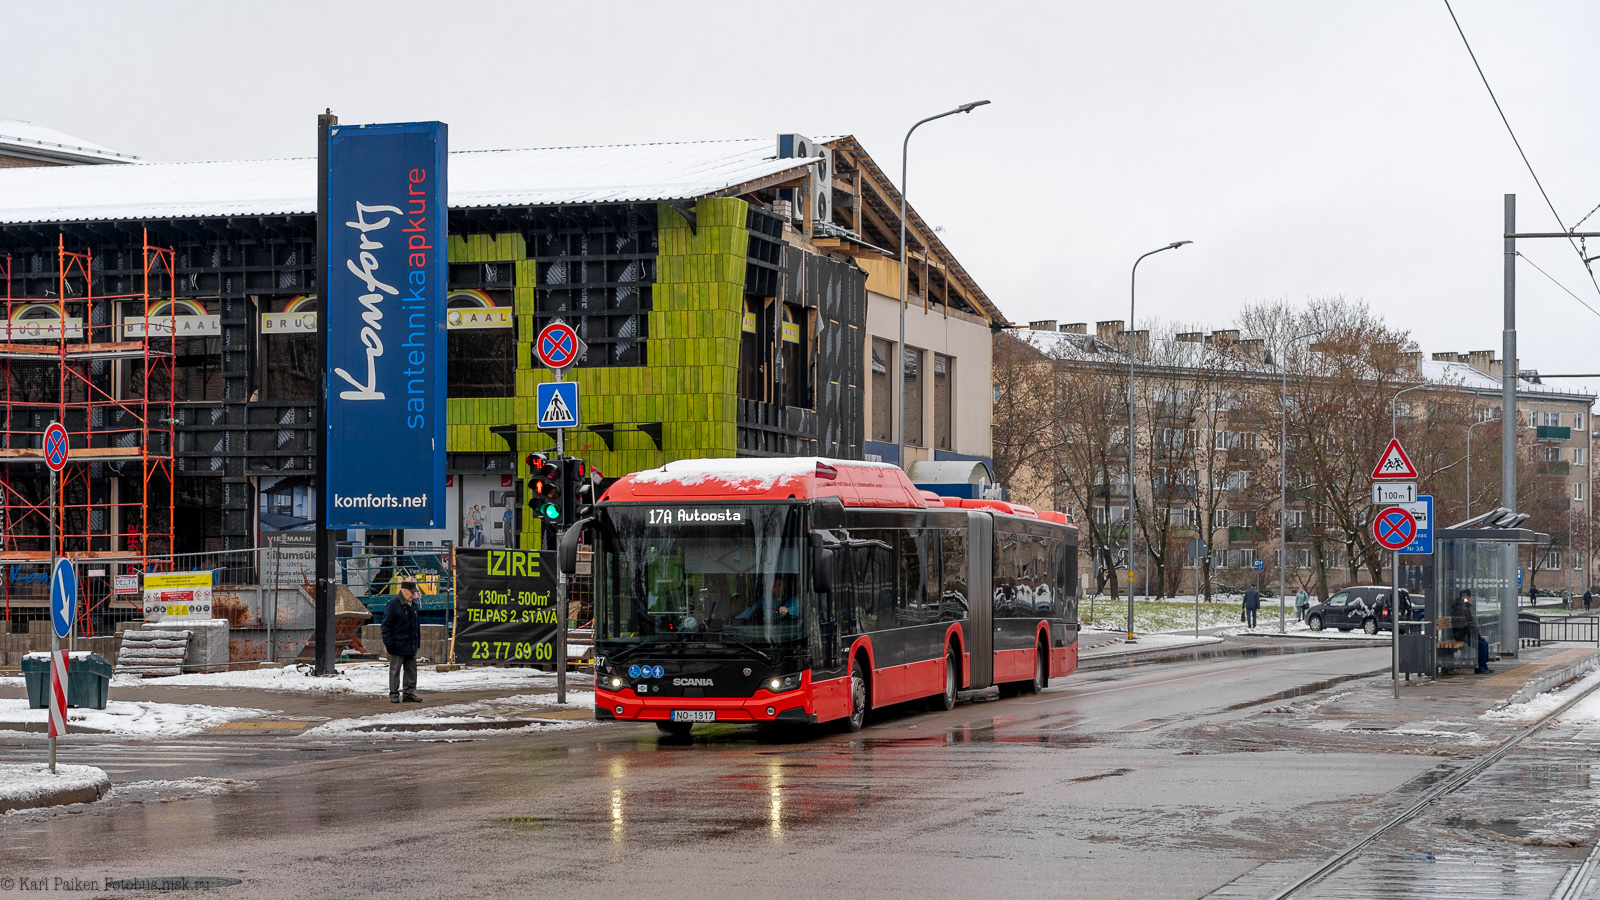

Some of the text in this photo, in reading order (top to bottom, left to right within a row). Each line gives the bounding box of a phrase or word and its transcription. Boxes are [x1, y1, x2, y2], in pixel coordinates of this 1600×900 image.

[334, 493, 428, 509] komforts.net
[649, 509, 741, 524] 17A Autoosta
[487, 547, 541, 578] IZĪRĒ
[467, 607, 558, 624] TELPAS 2. STĀVĀ
[472, 641, 553, 660] 23 77 69 60
[672, 677, 714, 687] SCANIA
[676, 711, 714, 720] NO-1917
